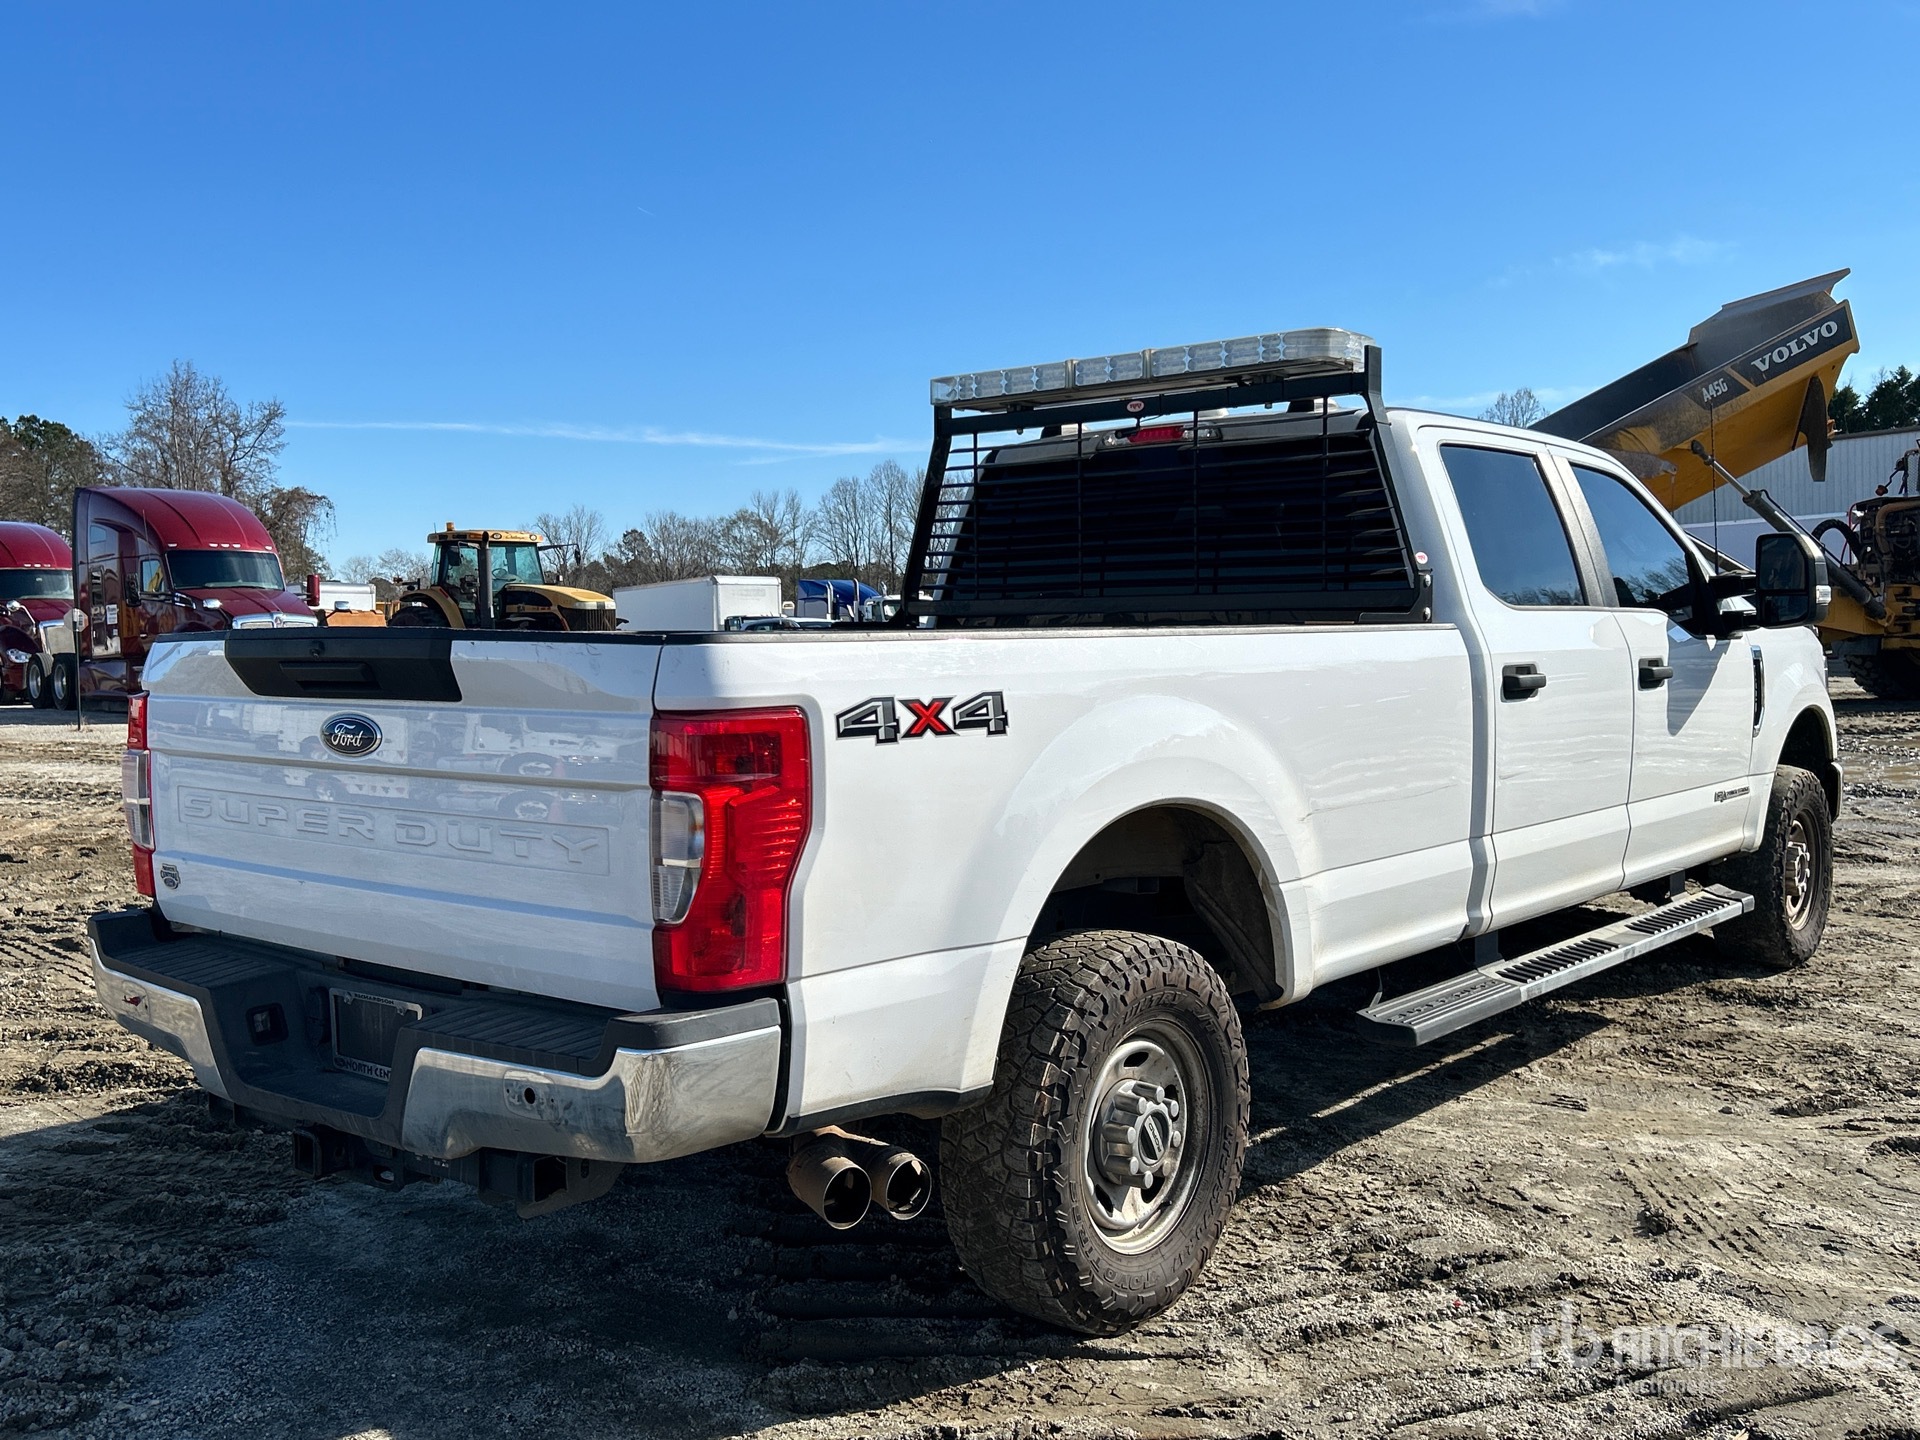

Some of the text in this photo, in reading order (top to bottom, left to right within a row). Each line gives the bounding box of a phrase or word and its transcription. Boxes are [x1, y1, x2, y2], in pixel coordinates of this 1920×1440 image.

[1751, 320, 1838, 372] VOLVO
[1702, 378, 1728, 402] A45G
[331, 722, 363, 747] Ford
[184, 793, 599, 864] SUPER DUTY
[345, 1058, 373, 1076] NORTH
[1103, 1267, 1159, 1291] TOYO
